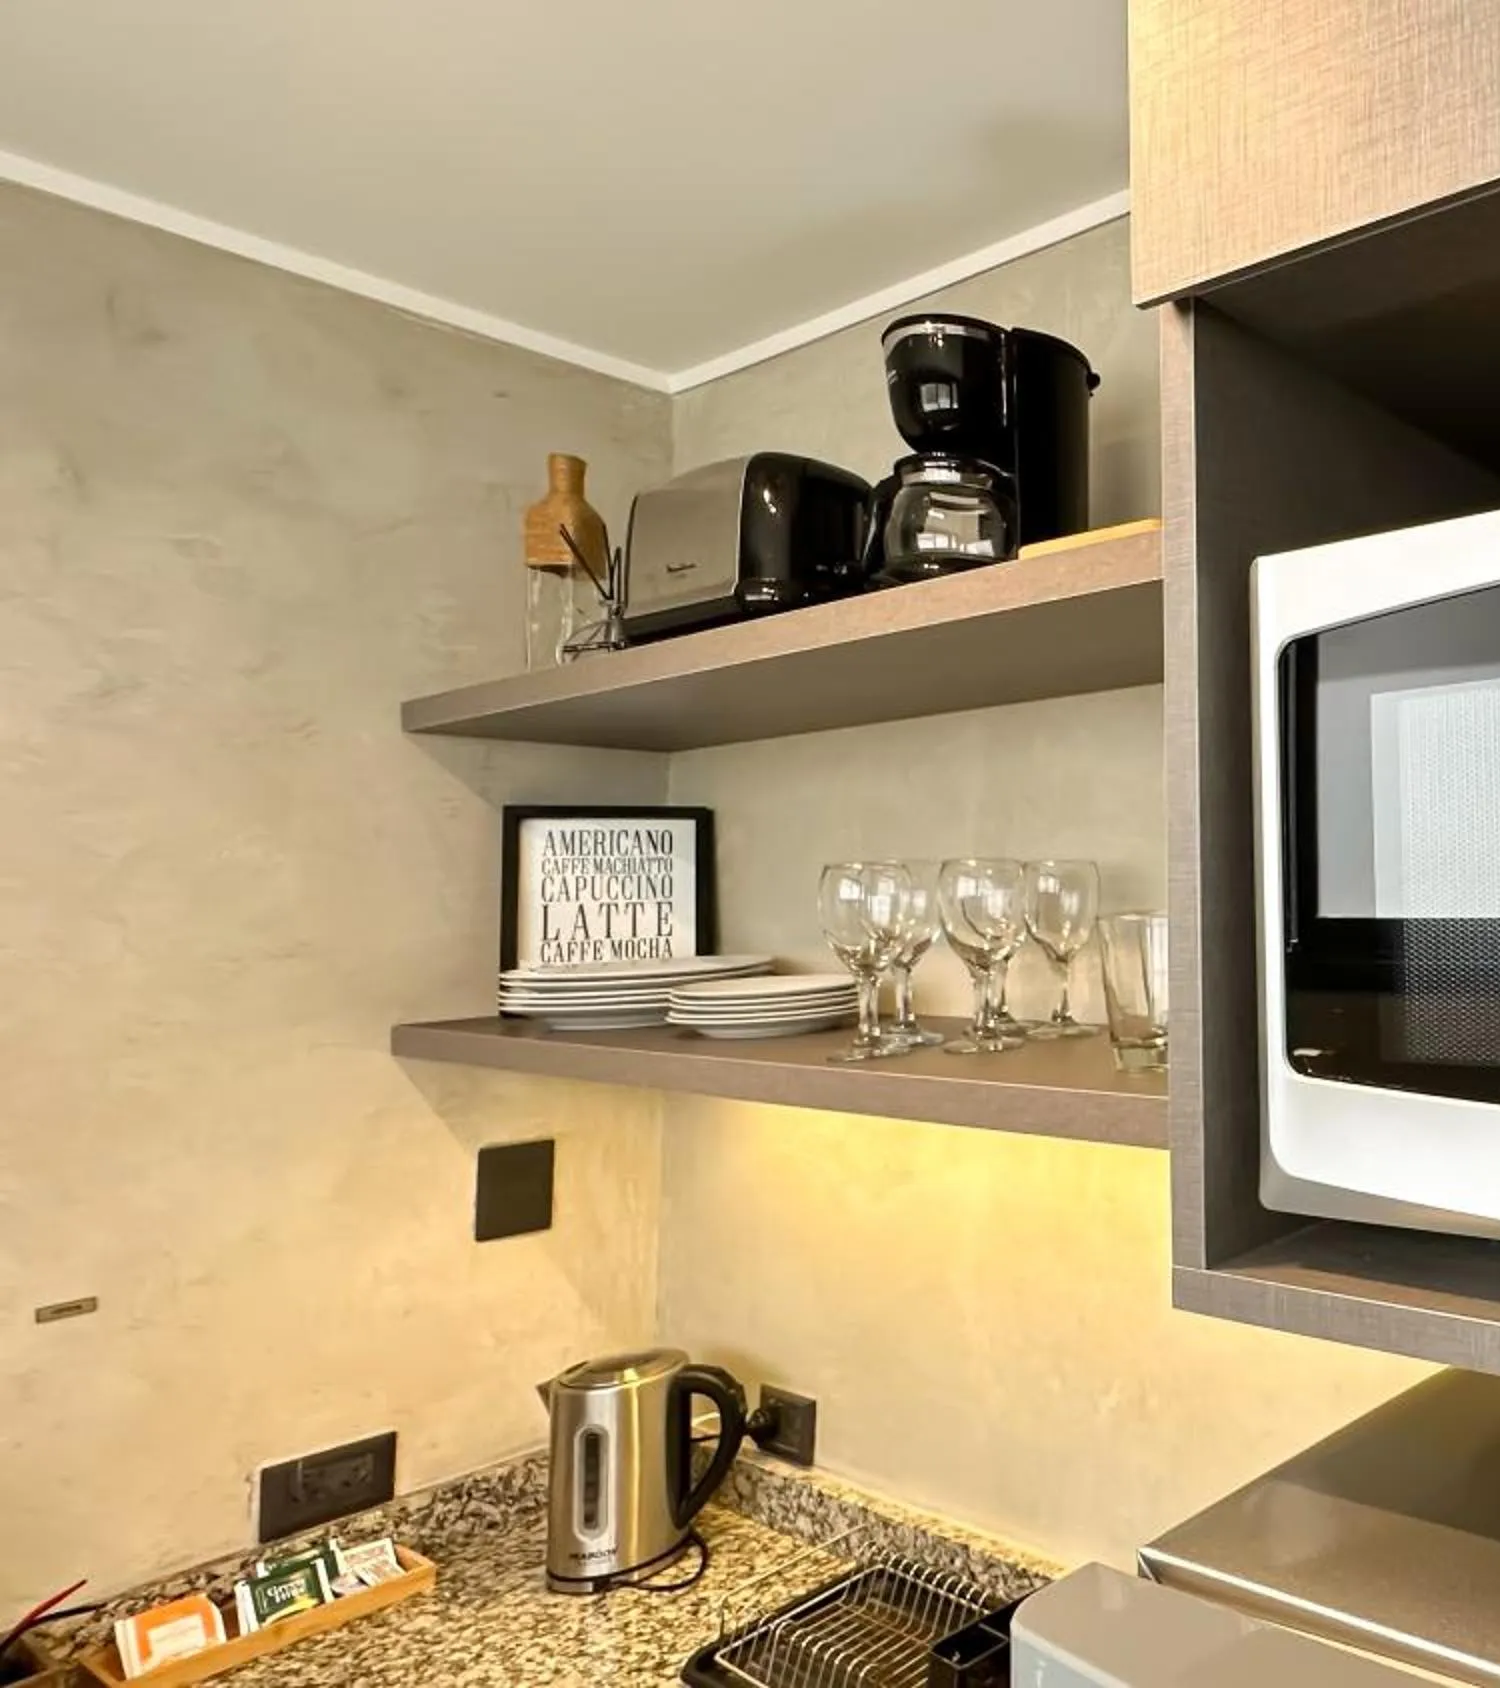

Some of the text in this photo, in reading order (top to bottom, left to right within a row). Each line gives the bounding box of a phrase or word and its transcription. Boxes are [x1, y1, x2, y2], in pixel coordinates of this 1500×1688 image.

[543, 829, 674, 857] AMERICANO
[541, 856, 673, 875] CAFFE MACHIATTO
[541, 875, 673, 902] CAPUCCINO
[542, 901, 673, 941] LATTE
[540, 937, 673, 963] CAFFE MOCHA
